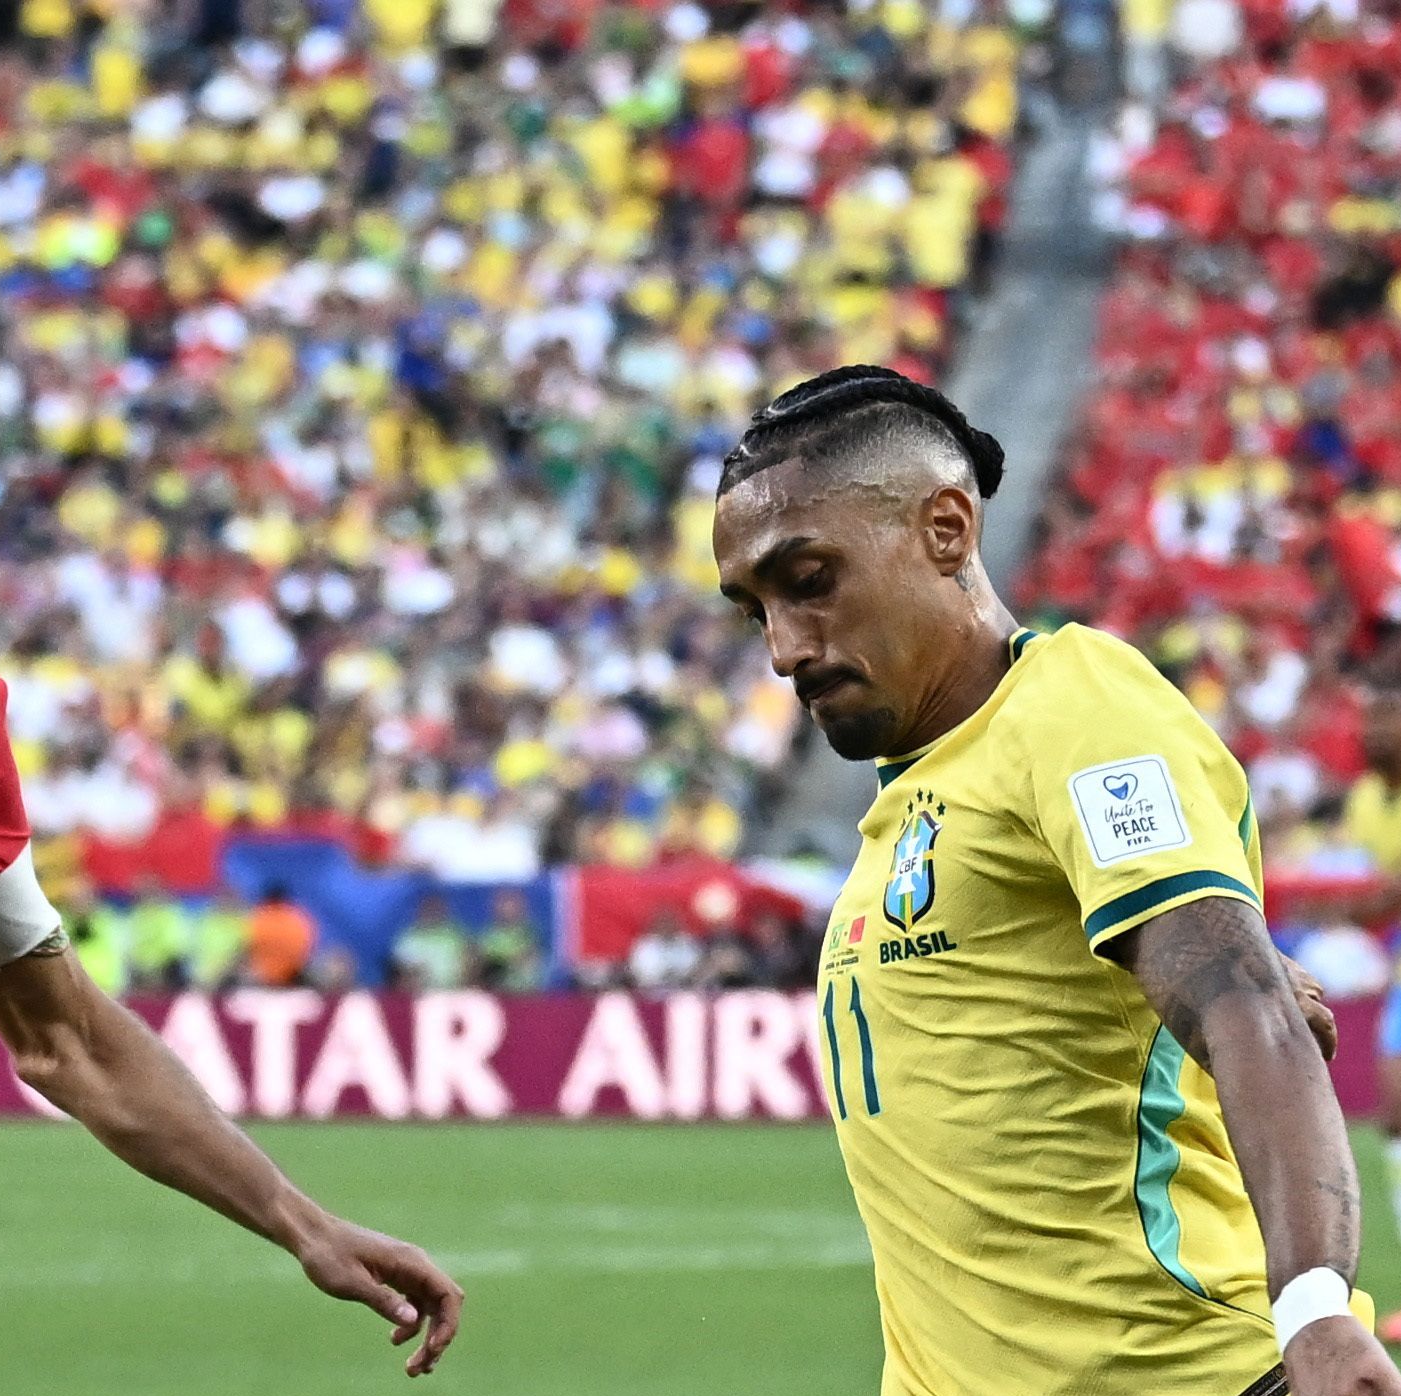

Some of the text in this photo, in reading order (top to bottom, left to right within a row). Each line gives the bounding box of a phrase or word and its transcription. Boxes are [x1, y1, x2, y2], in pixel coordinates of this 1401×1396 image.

[1104, 799, 1153, 822] Unite For
[1112, 816, 1158, 838] PEACE
[1127, 835, 1152, 847] FIFA
[898, 856, 918, 875] CBF
[880, 930, 957, 964] BRASIL
[11, 989, 828, 1120] ATAR AIR
[822, 975, 881, 1121] 11
